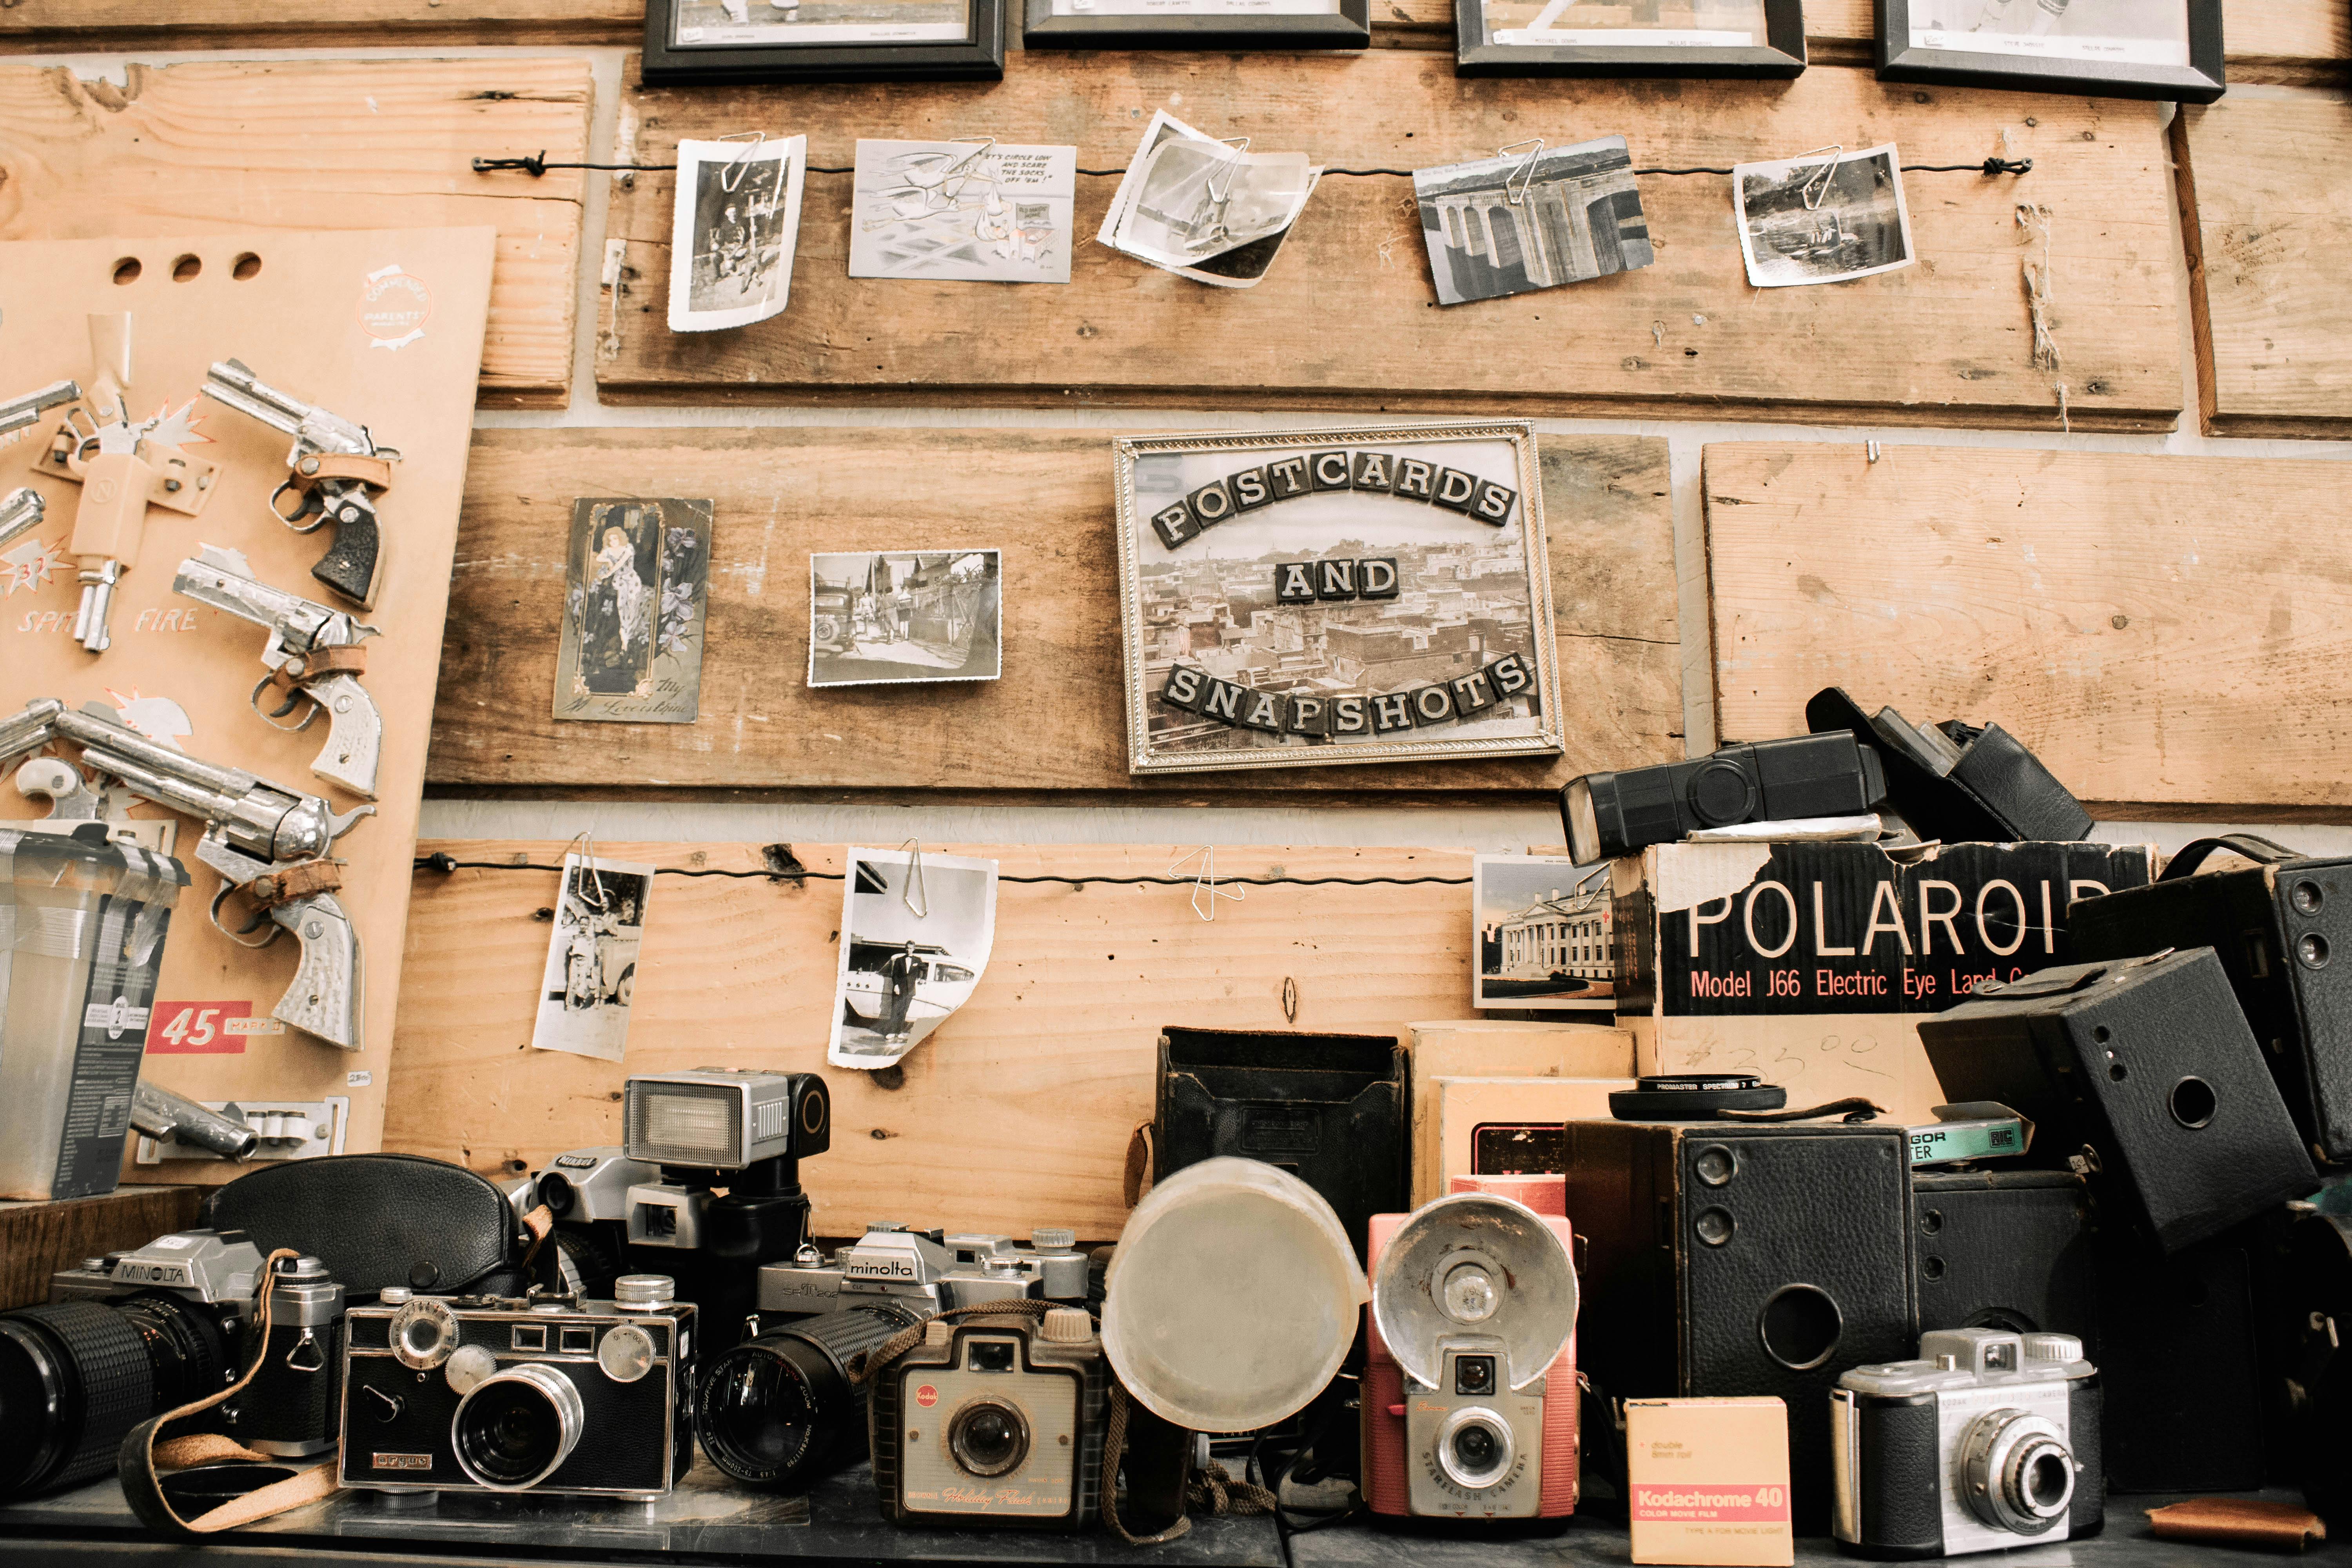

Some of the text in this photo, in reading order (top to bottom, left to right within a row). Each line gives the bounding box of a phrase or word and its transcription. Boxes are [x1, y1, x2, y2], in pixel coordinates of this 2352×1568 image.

[1159, 453, 1511, 541] POSTCARDS
[1281, 561, 1396, 597] AND
[133, 608, 199, 632] FIRE
[1169, 659, 1526, 732] SNAPSHOTS
[1689, 879, 2111, 958] POLAROI
[1691, 971, 1751, 997] Model
[1766, 970, 1800, 996] J66
[1816, 969, 1887, 996] Electric
[1903, 968, 1936, 999] Eye
[162, 1008, 220, 1045] 45
[121, 1265, 185, 1282] MINOLTA
[851, 1261, 913, 1276] minolta
[752, 1351, 773, 1360] AUTO
[715, 1358, 733, 1376] STAR
[776, 1360, 800, 1381] MACRO
[800, 1385, 811, 1409] ZOOM
[917, 1392, 937, 1400] Kodak
[2037, 1389, 2068, 1398] CAMERA
[1651, 1441, 1683, 1450] double
[378, 1456, 427, 1468] argus
[722, 1455, 752, 1477] 75-200mm
[1490, 1453, 1528, 1497] CAMERA
[907, 1488, 1067, 1510] BROWNIE Holiday Flash CAMERA
[1638, 1487, 1783, 1507] Kodachrome 40
